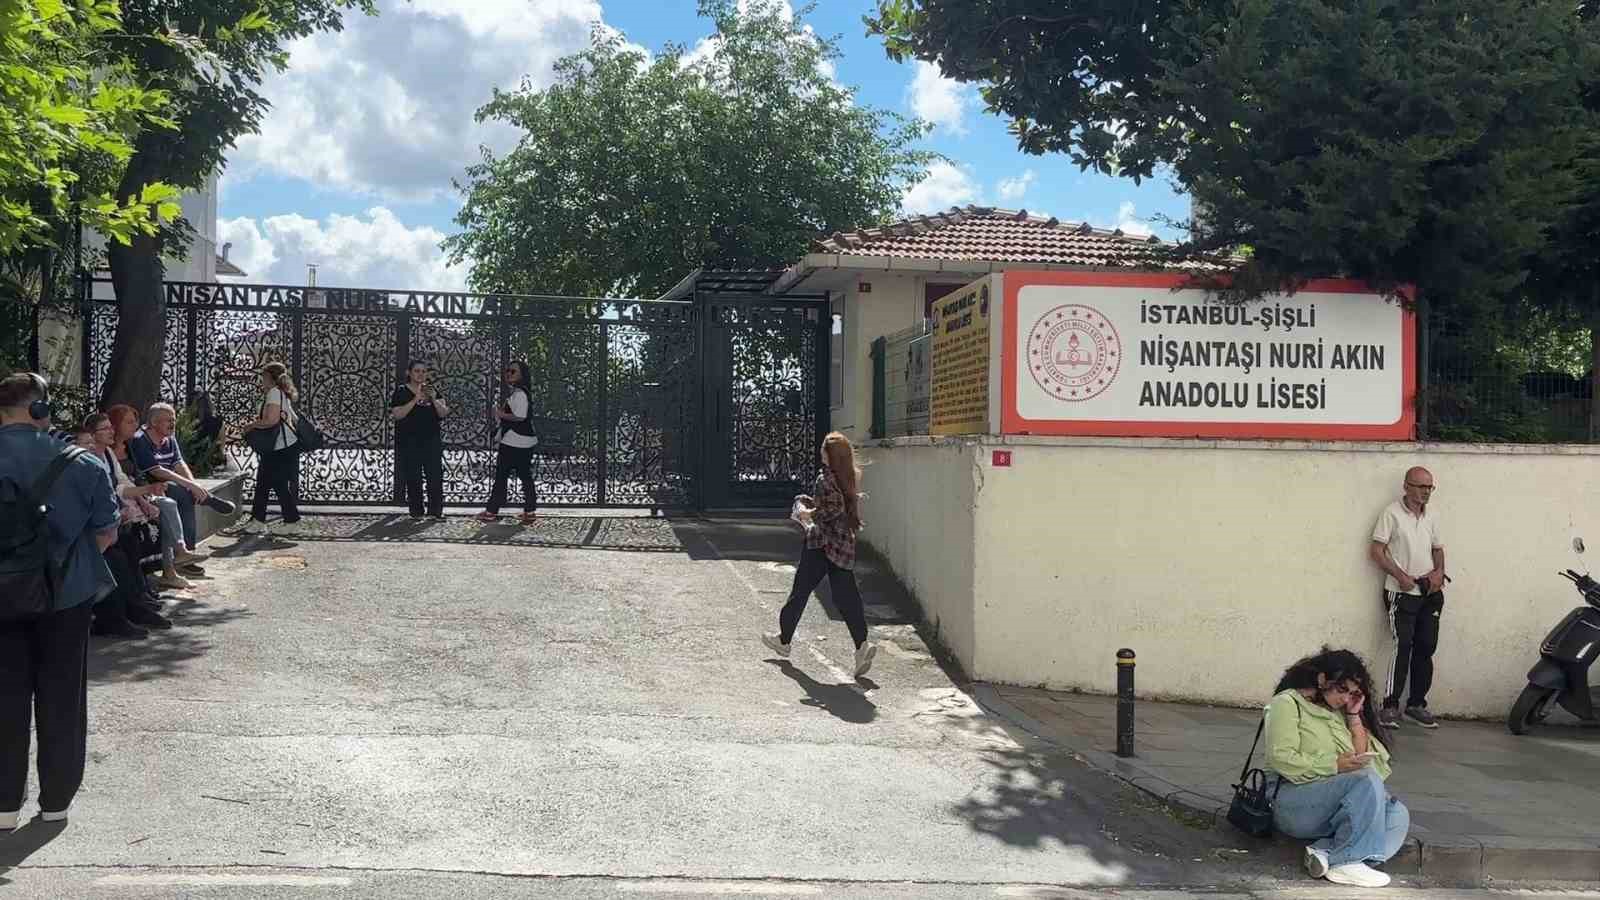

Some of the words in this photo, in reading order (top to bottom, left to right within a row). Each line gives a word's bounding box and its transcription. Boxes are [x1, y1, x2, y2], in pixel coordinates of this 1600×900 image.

[405, 293, 467, 315] AKIN
[1140, 300, 1316, 331] İSTANBUL-ŞİŞLİ
[1140, 334, 1261, 373] NİŞANTAŞI
[1270, 338, 1323, 369] NURİ
[1331, 344, 1385, 370] AKIN
[1138, 381, 1249, 408] ANADOLU
[1256, 378, 1326, 409] LİSESİ
